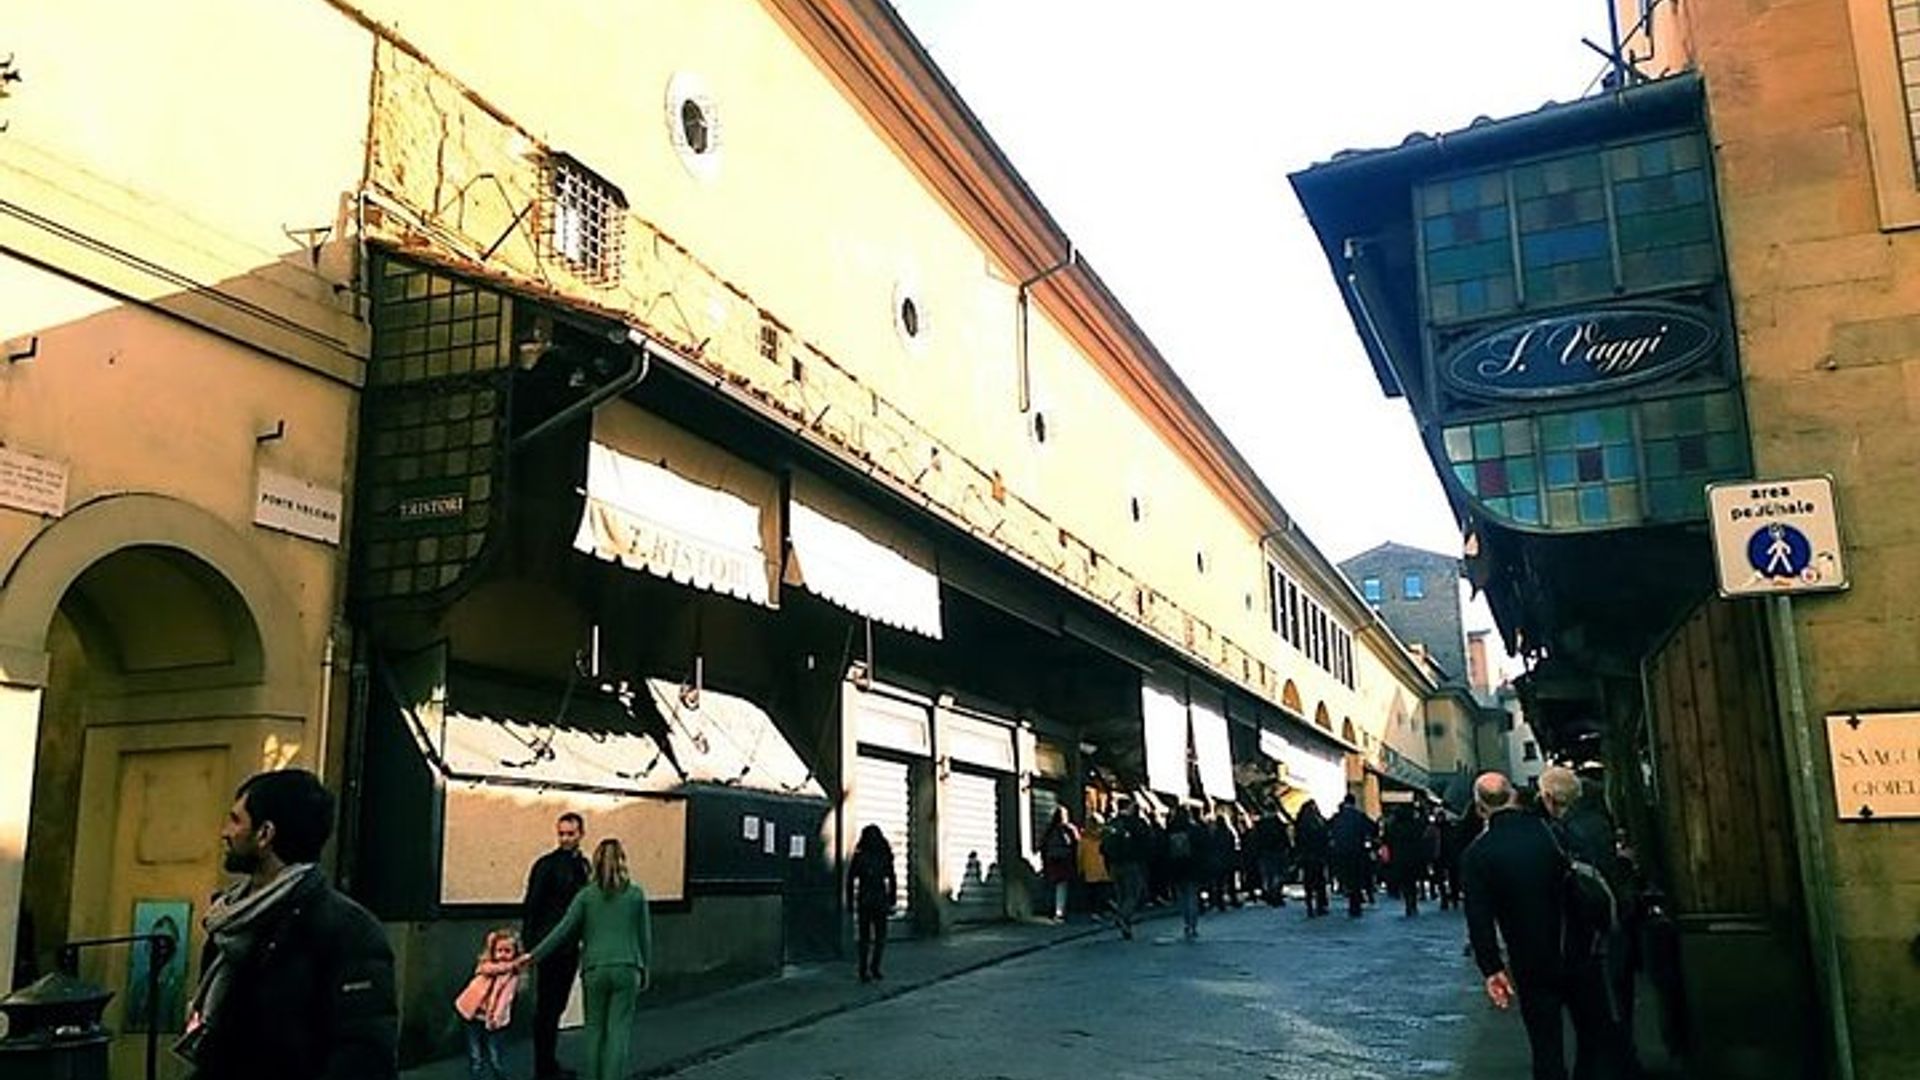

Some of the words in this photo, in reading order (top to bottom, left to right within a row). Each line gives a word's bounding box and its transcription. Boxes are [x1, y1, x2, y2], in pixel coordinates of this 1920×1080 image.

[1545, 320, 1669, 374] Vaggi
[261, 492, 293, 510] PONTE
[1750, 486, 1791, 499] area
